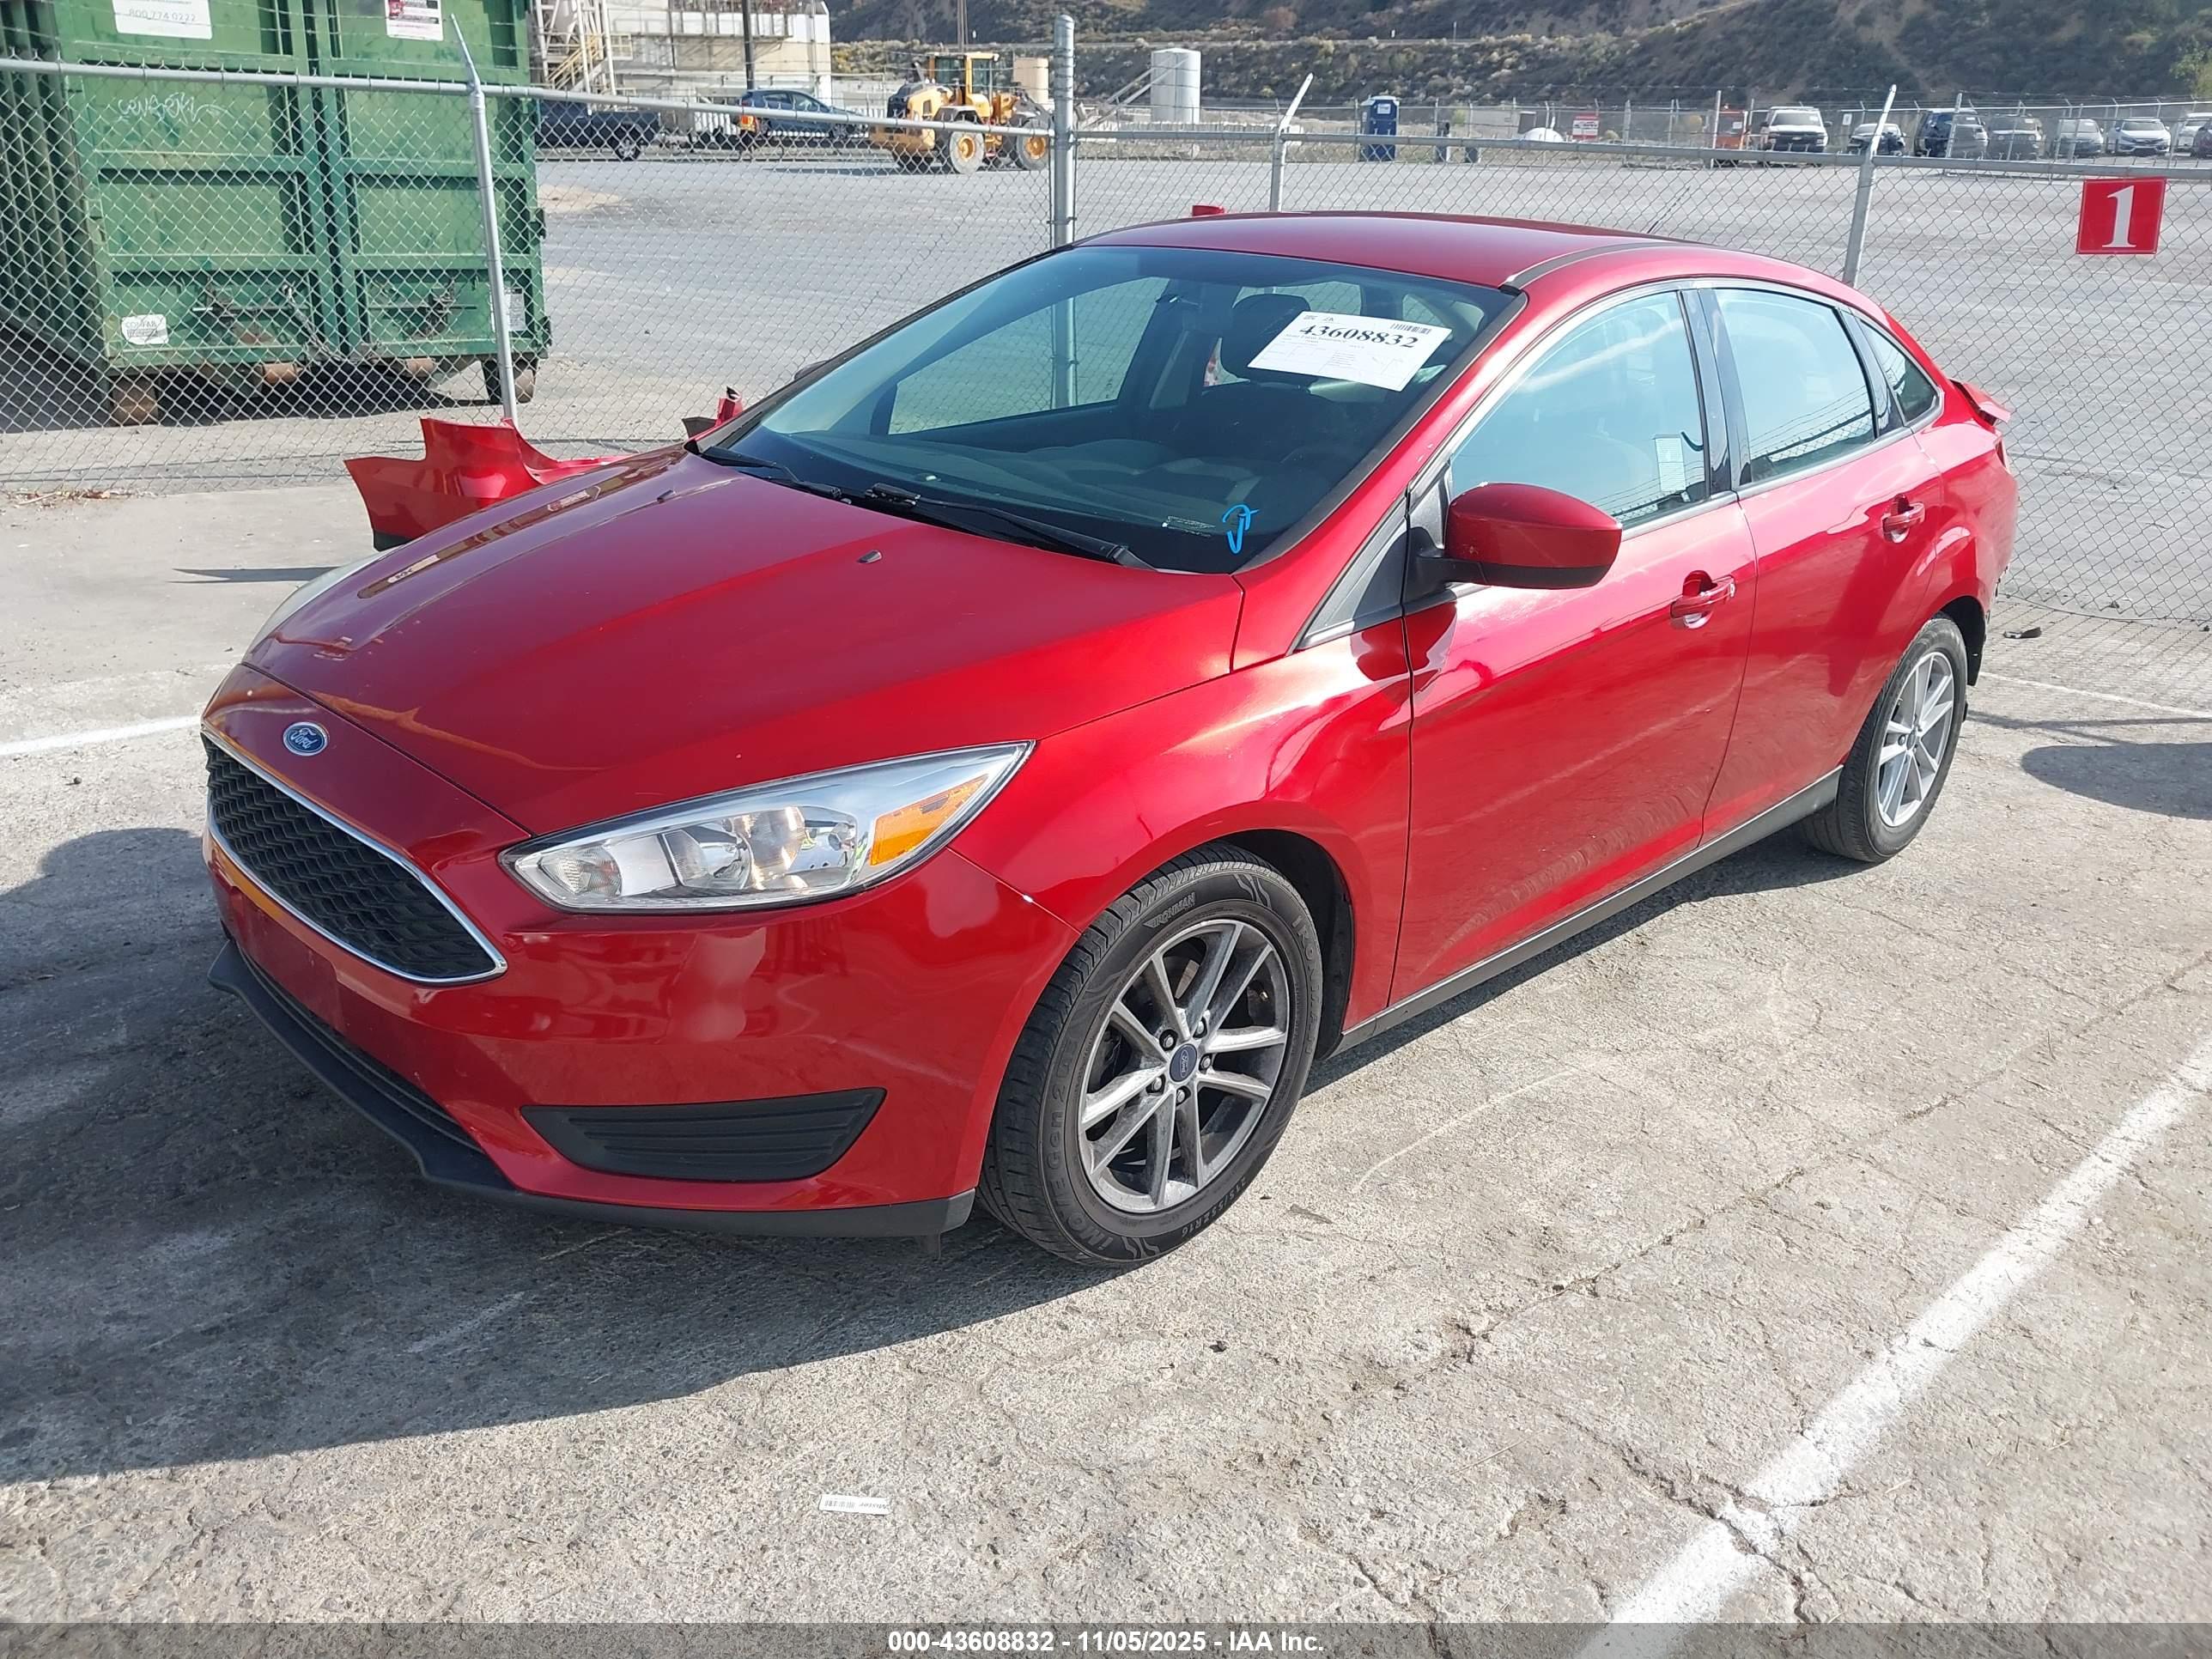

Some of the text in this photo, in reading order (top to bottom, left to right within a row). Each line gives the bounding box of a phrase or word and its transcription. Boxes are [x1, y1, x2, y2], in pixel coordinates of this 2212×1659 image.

[2102, 185, 2137, 247] 1
[1299, 325, 1418, 349] 43608832
[290, 727, 318, 750] Ford
[1149, 891, 1196, 927] IRONMAN
